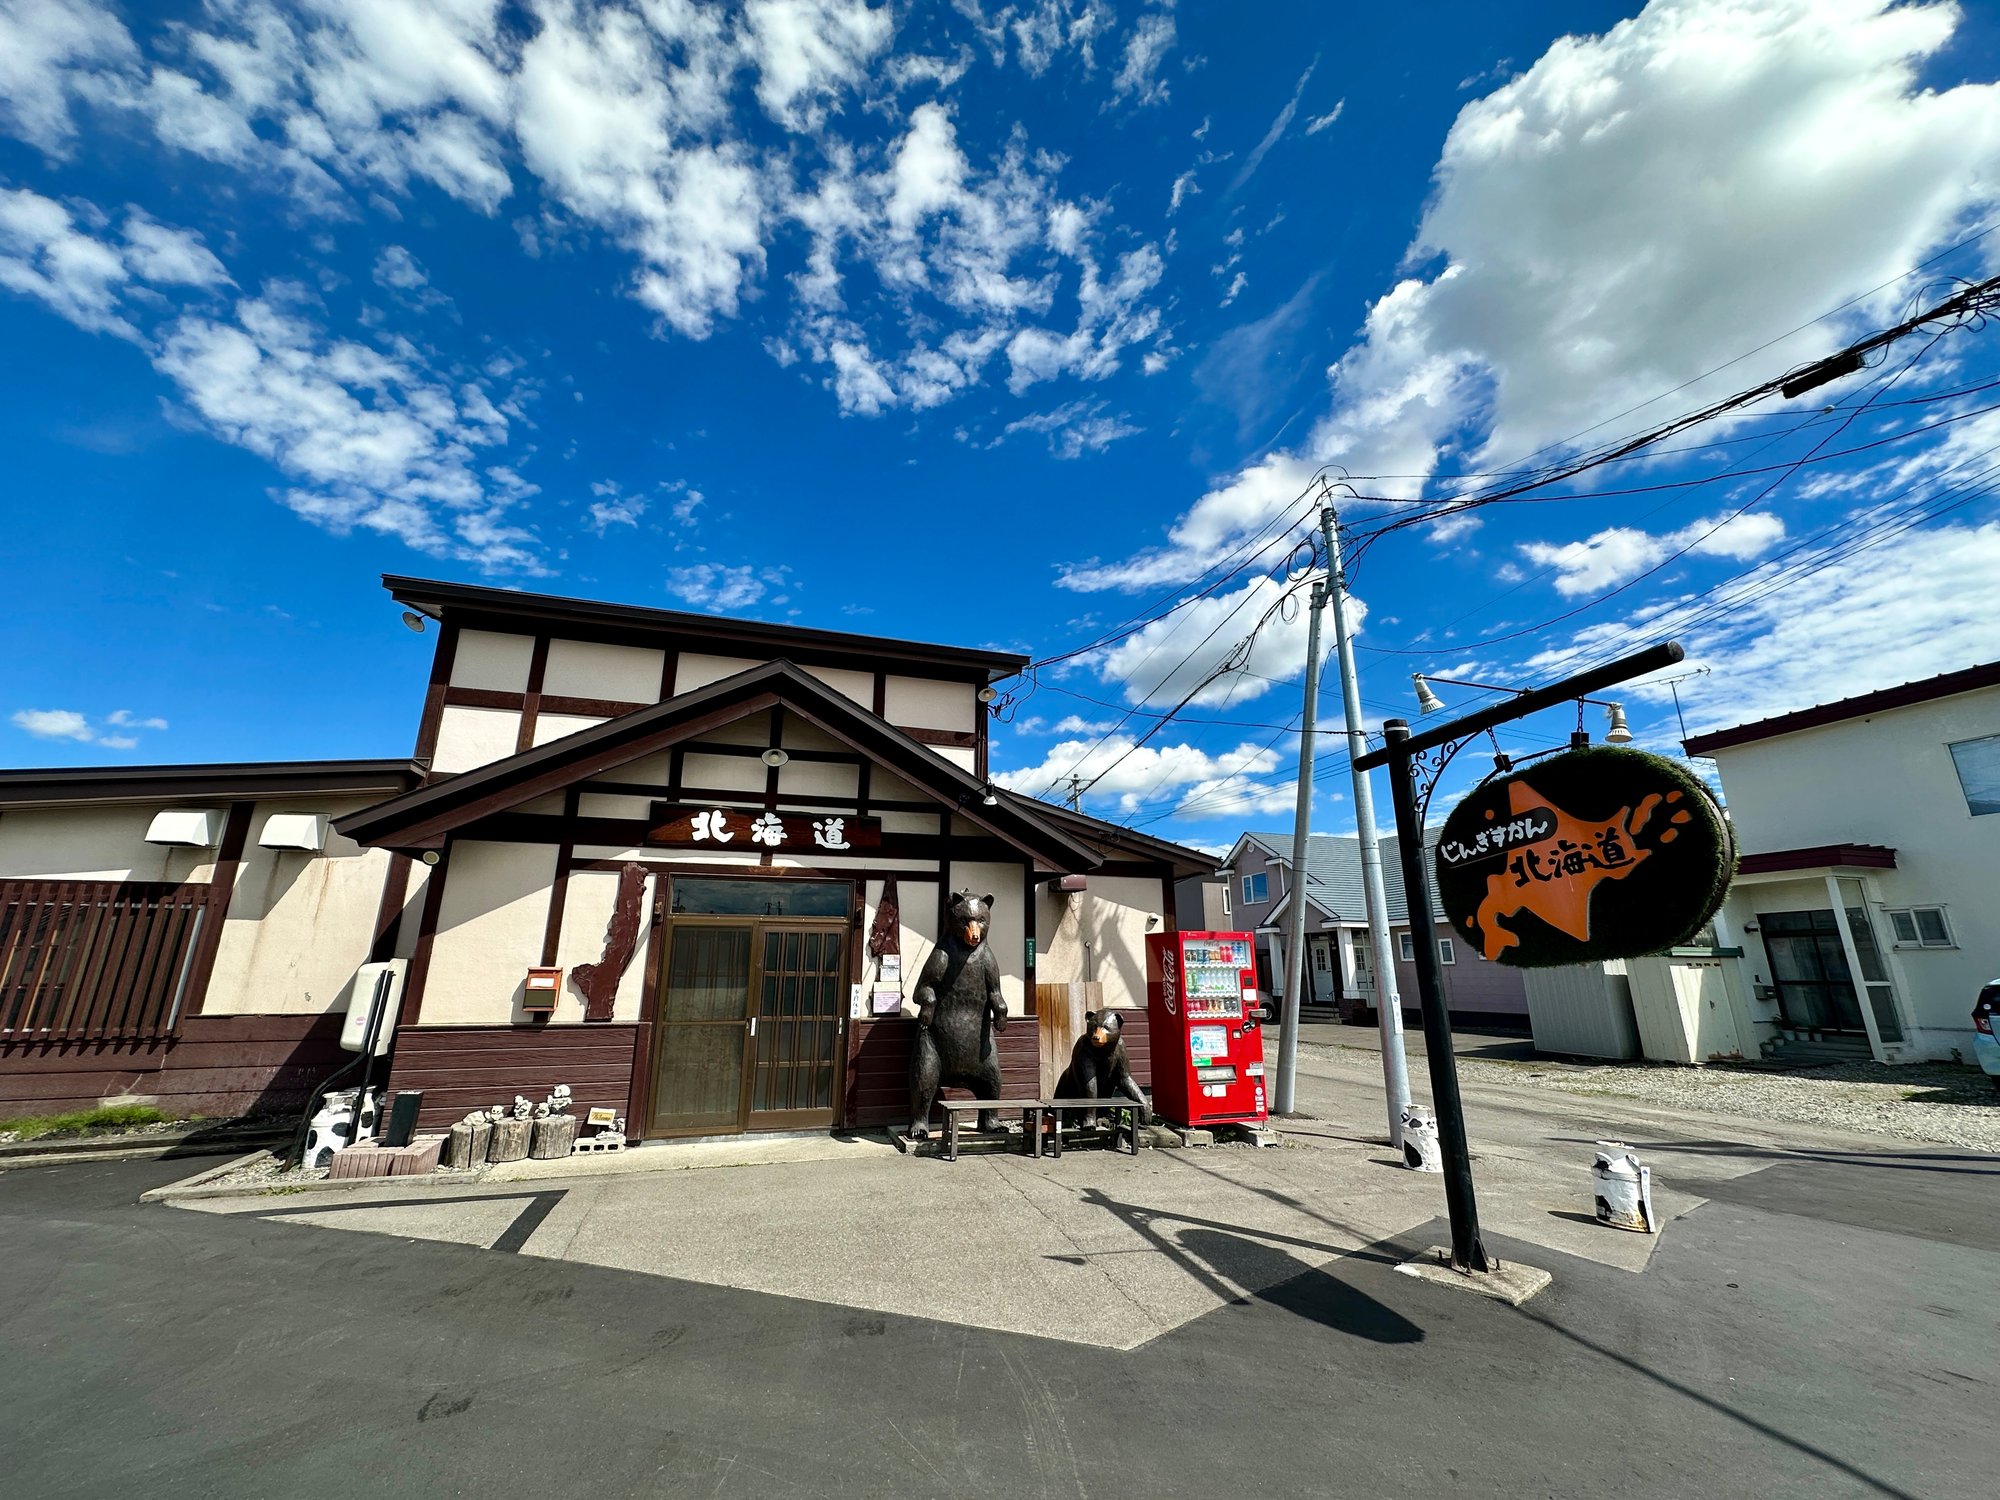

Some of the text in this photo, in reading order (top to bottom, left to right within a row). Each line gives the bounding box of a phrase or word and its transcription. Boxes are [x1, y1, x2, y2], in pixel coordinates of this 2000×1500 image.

[690, 809, 851, 850] 北海道
[1440, 818, 1548, 863] じんぎすかん
[1509, 826, 1636, 888] 北海道
[1162, 946, 1177, 1015] Coca-Cola
